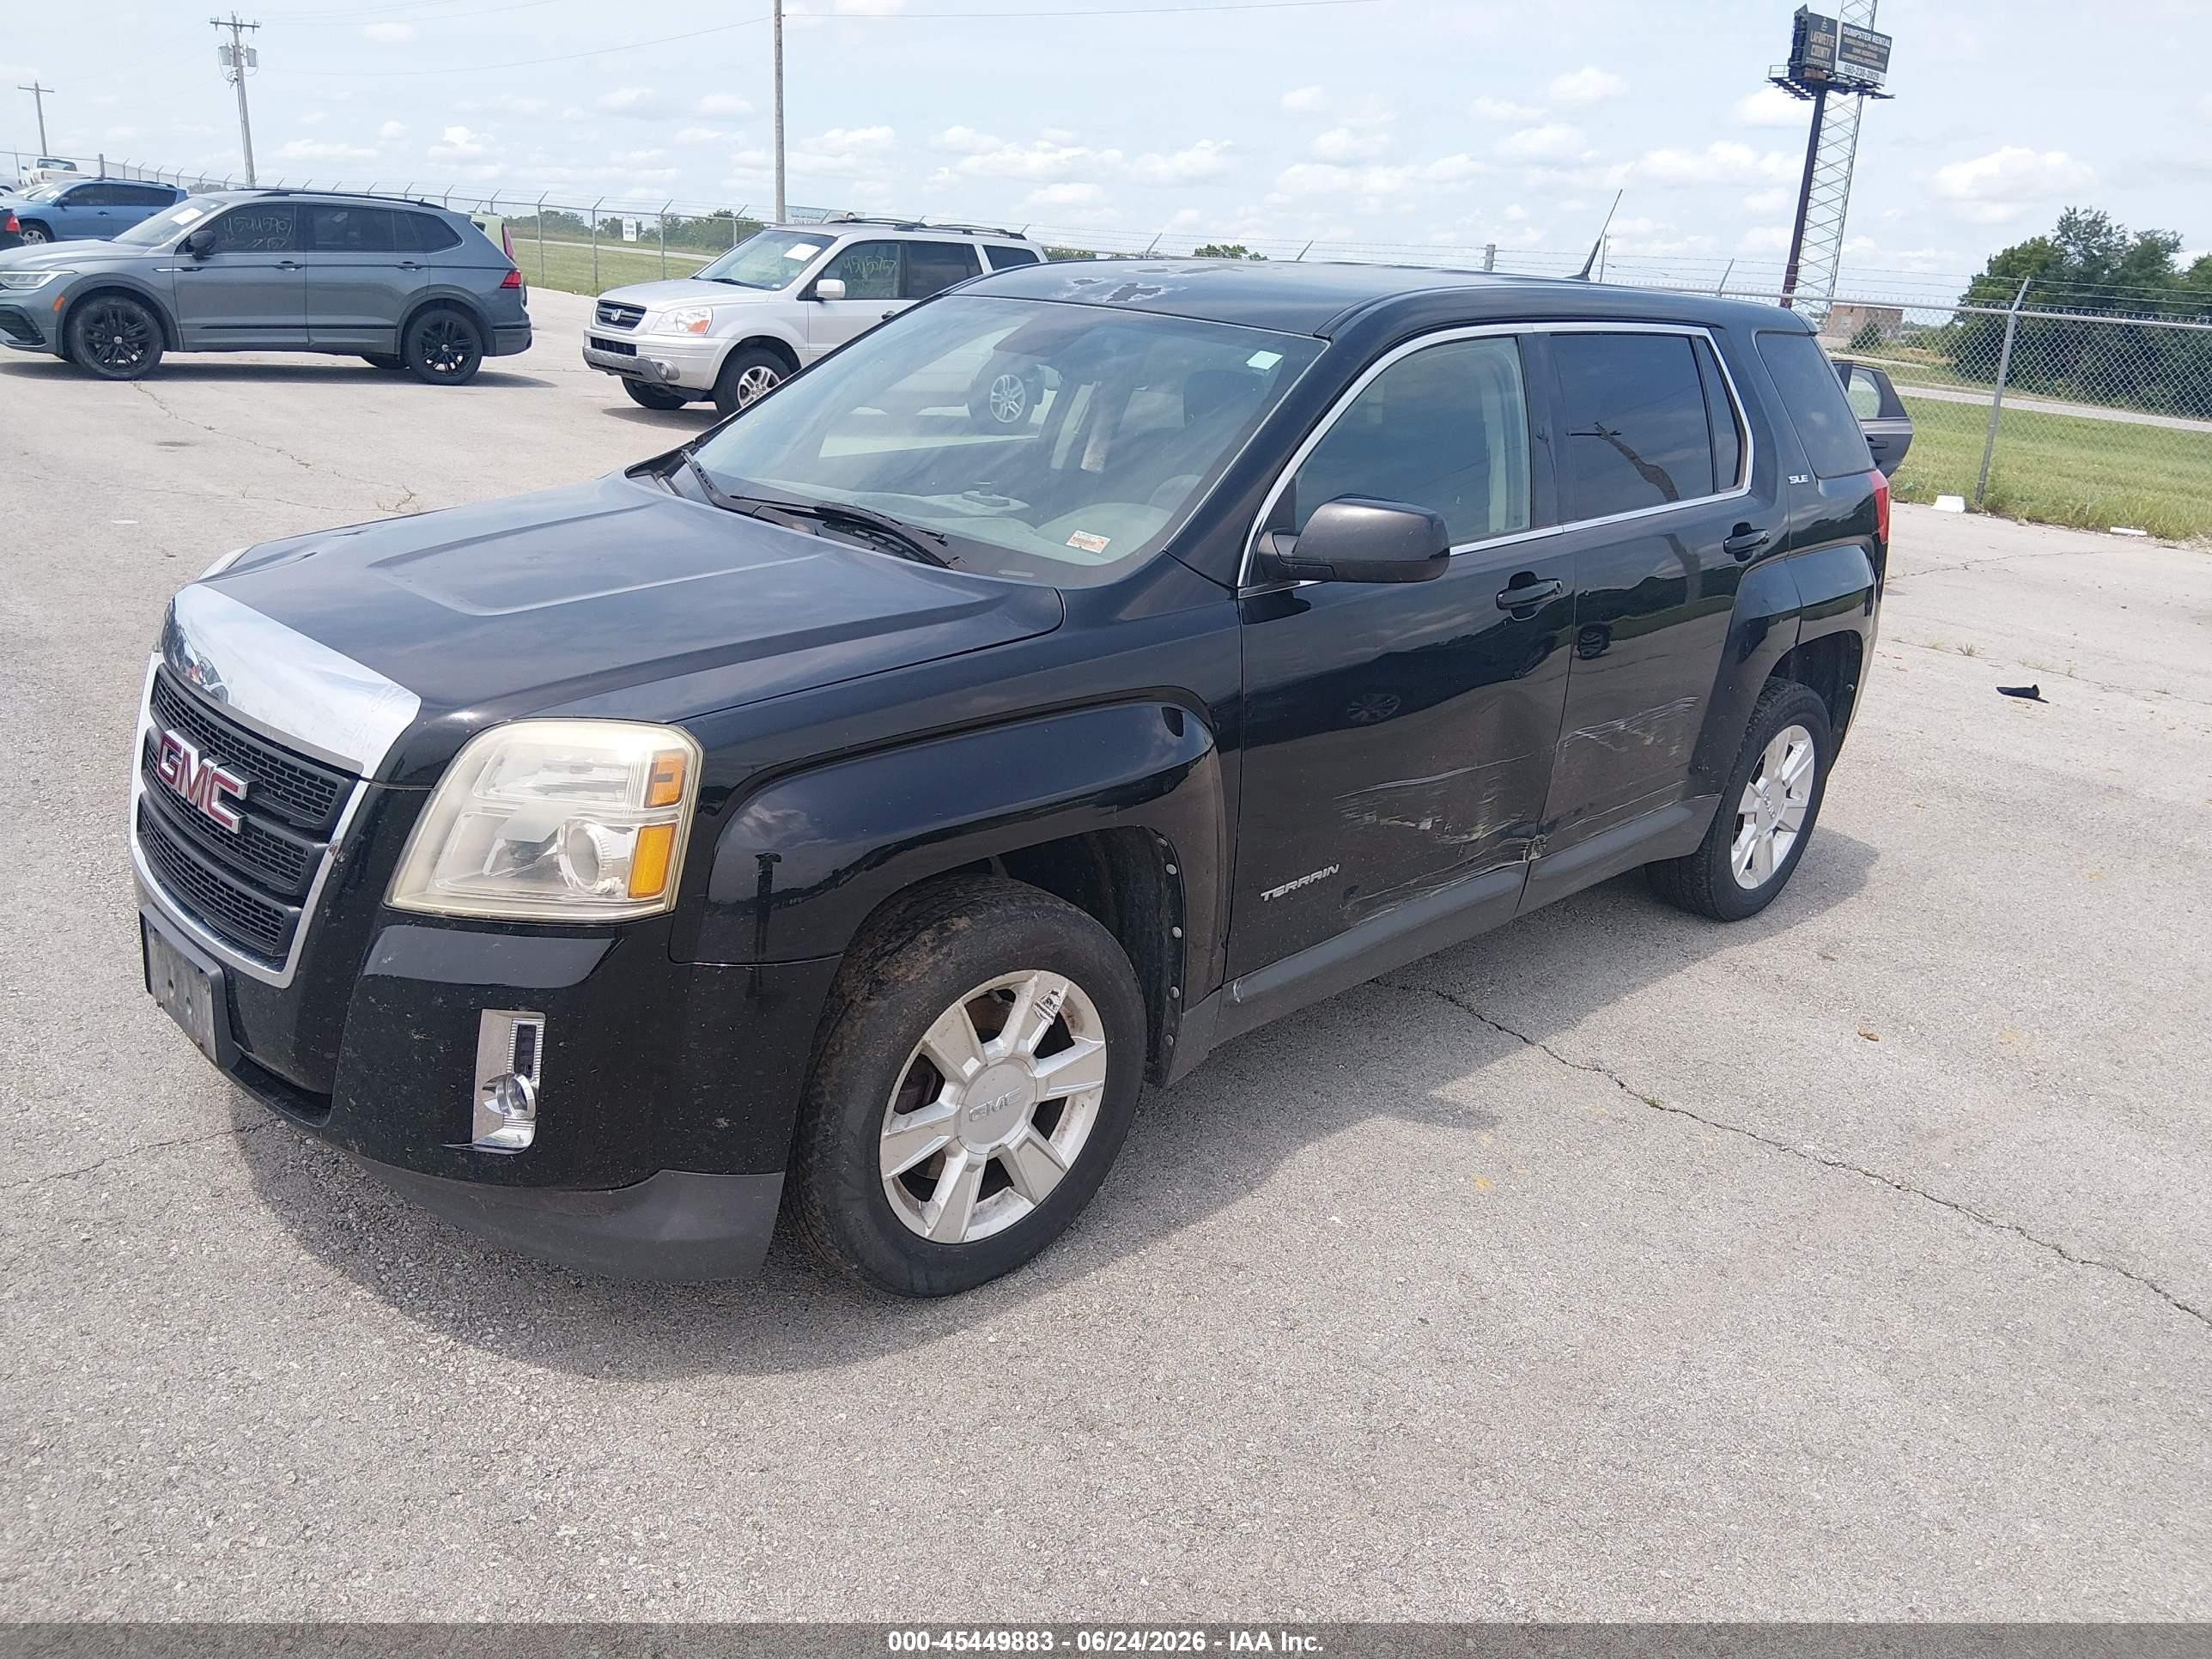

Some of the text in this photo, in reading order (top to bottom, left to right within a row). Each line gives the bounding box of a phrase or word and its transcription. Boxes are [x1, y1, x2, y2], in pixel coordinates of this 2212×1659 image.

[1788, 474, 1809, 485] SLE
[157, 729, 247, 835] GMC
[1260, 863, 1340, 902] TERRAIN
[969, 1087, 1023, 1121] GMC
